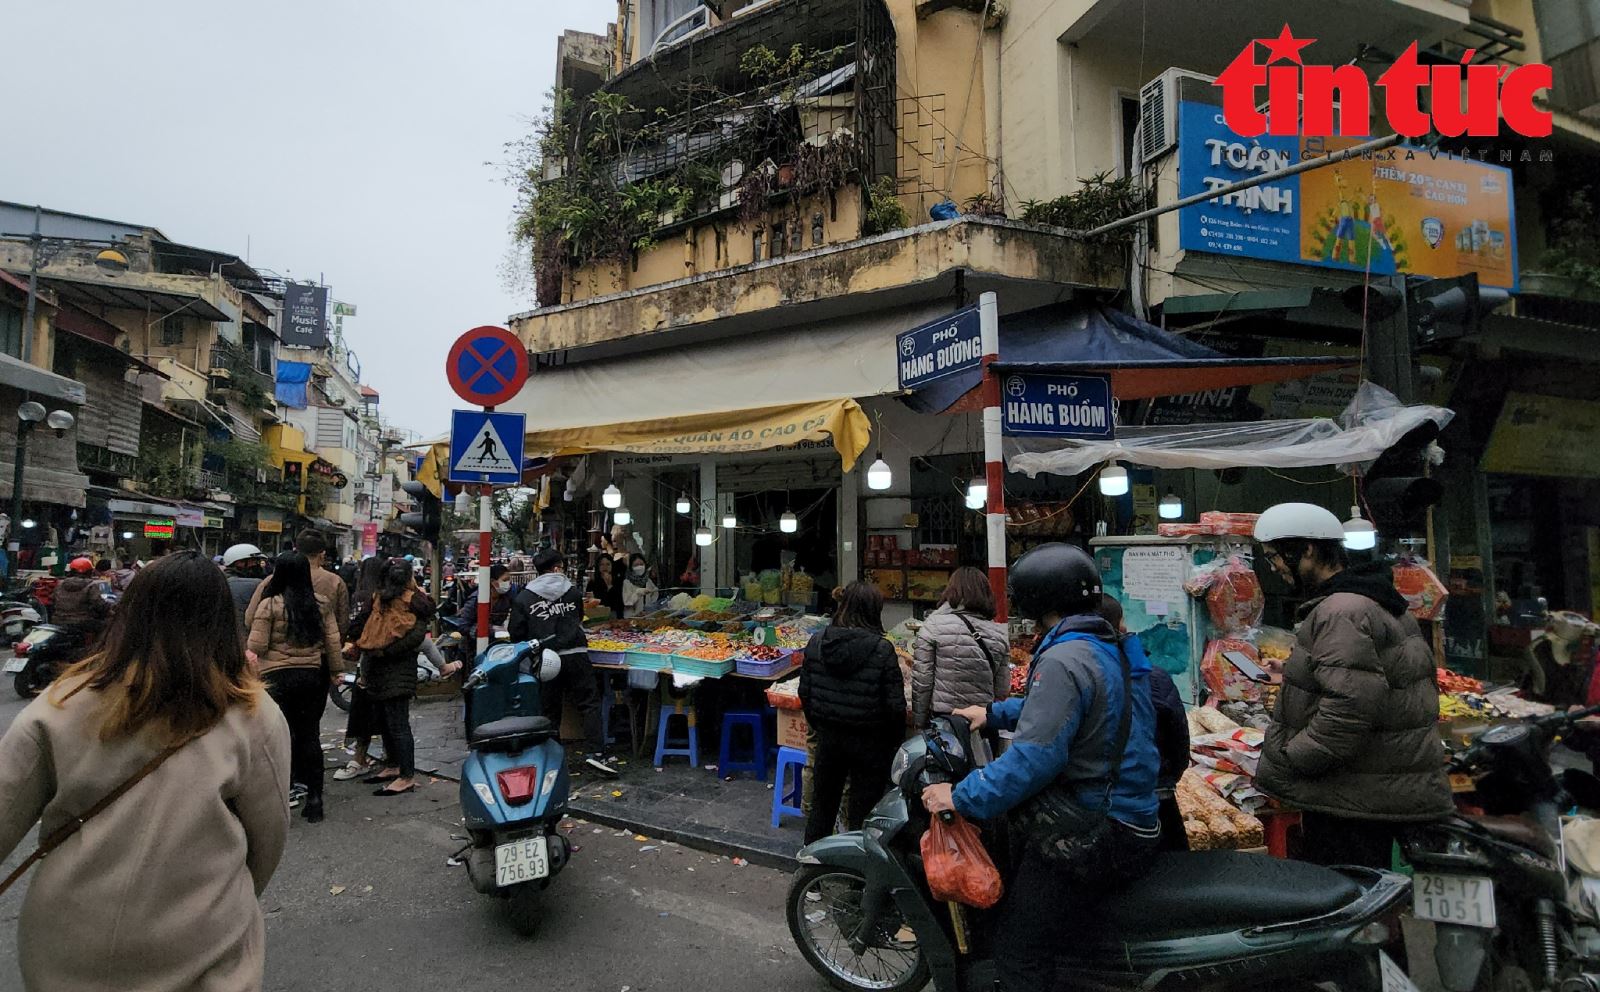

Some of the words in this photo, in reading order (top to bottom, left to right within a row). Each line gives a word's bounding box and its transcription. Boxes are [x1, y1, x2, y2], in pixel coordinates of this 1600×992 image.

[1205, 138, 1290, 171] TOÀN
[291, 315, 318, 325] Music
[295, 325, 313, 334] Café
[932, 320, 959, 344] PHỐ
[902, 352, 934, 381] HÀNG
[937, 336, 981, 370] ĐƯỜNG
[1047, 381, 1079, 396] PHỐ
[1008, 398, 1054, 425] HÀNG
[1059, 399, 1106, 427] BUỒM
[761, 423, 796, 440] CAO
[504, 842, 539, 864] 29-E2
[500, 858, 544, 883] 756.93
[1422, 875, 1480, 900] 29-T7
[1427, 897, 1482, 922] 1051
